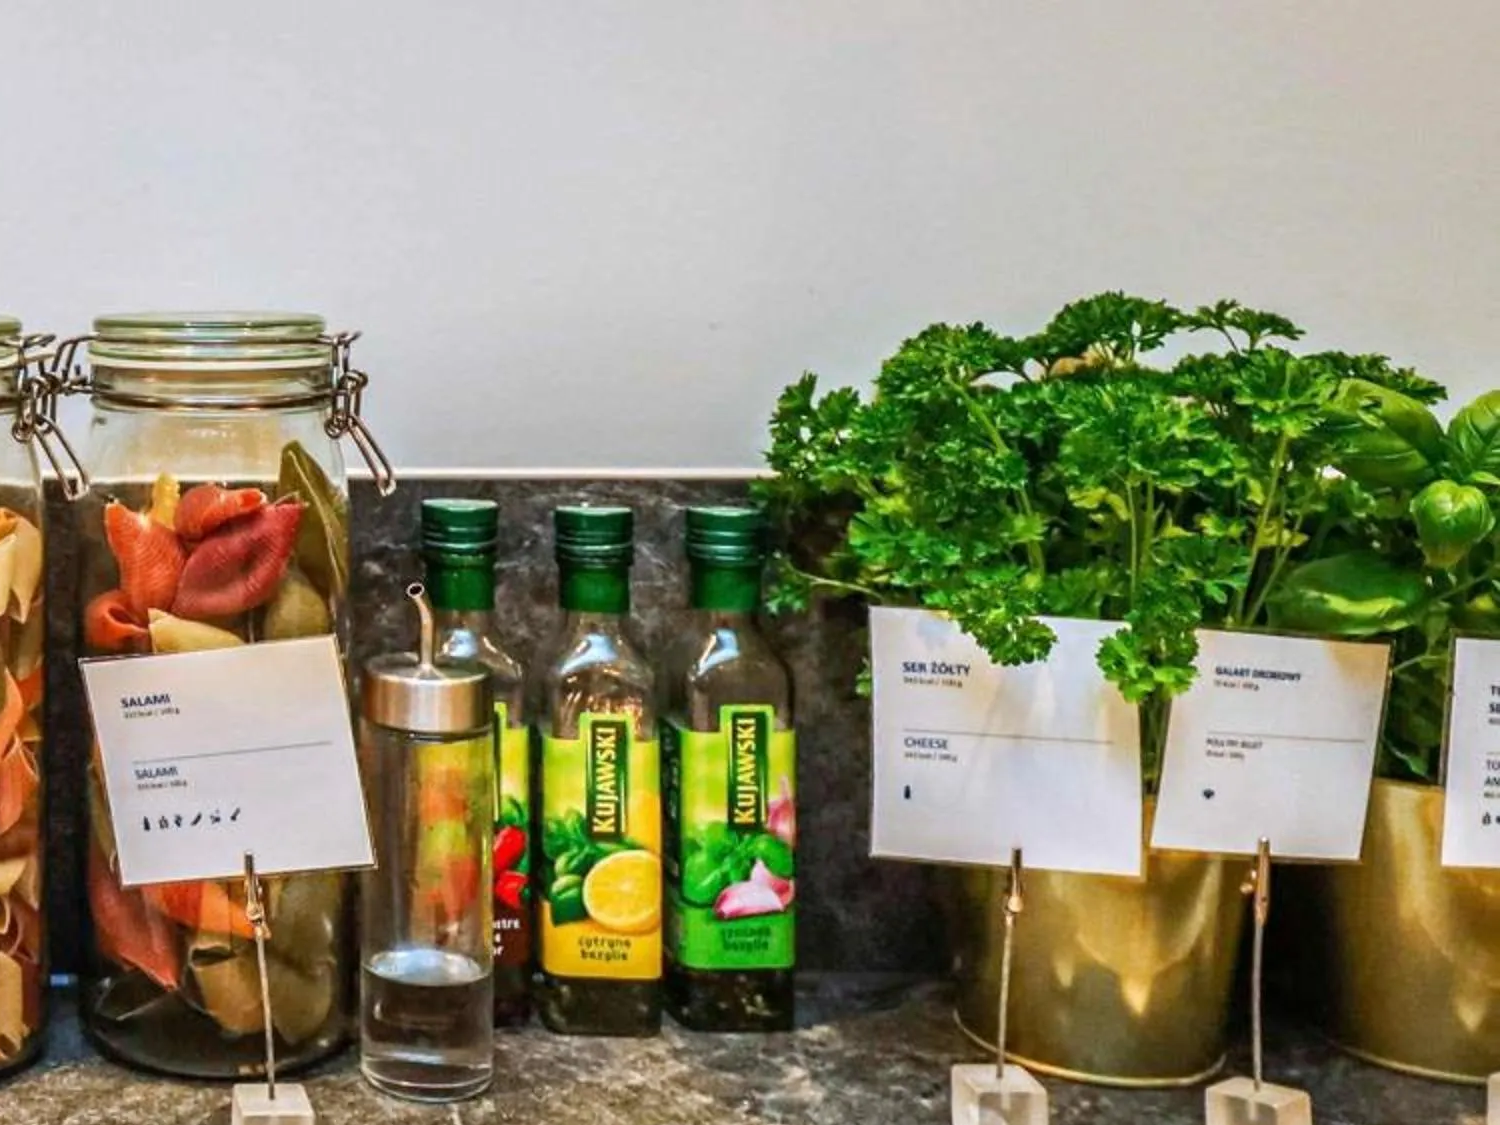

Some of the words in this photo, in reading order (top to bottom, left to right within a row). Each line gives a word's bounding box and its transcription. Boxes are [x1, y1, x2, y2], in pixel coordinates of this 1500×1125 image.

[902, 661, 927, 673] SER
[930, 660, 971, 676] ŻÓŁTY
[120, 692, 171, 708] SALAMI
[903, 736, 948, 750] CHEESE
[134, 766, 179, 780] SALAMI
[733, 717, 757, 825] KUJAWSKI
[592, 726, 616, 834] KUJAWSKI
